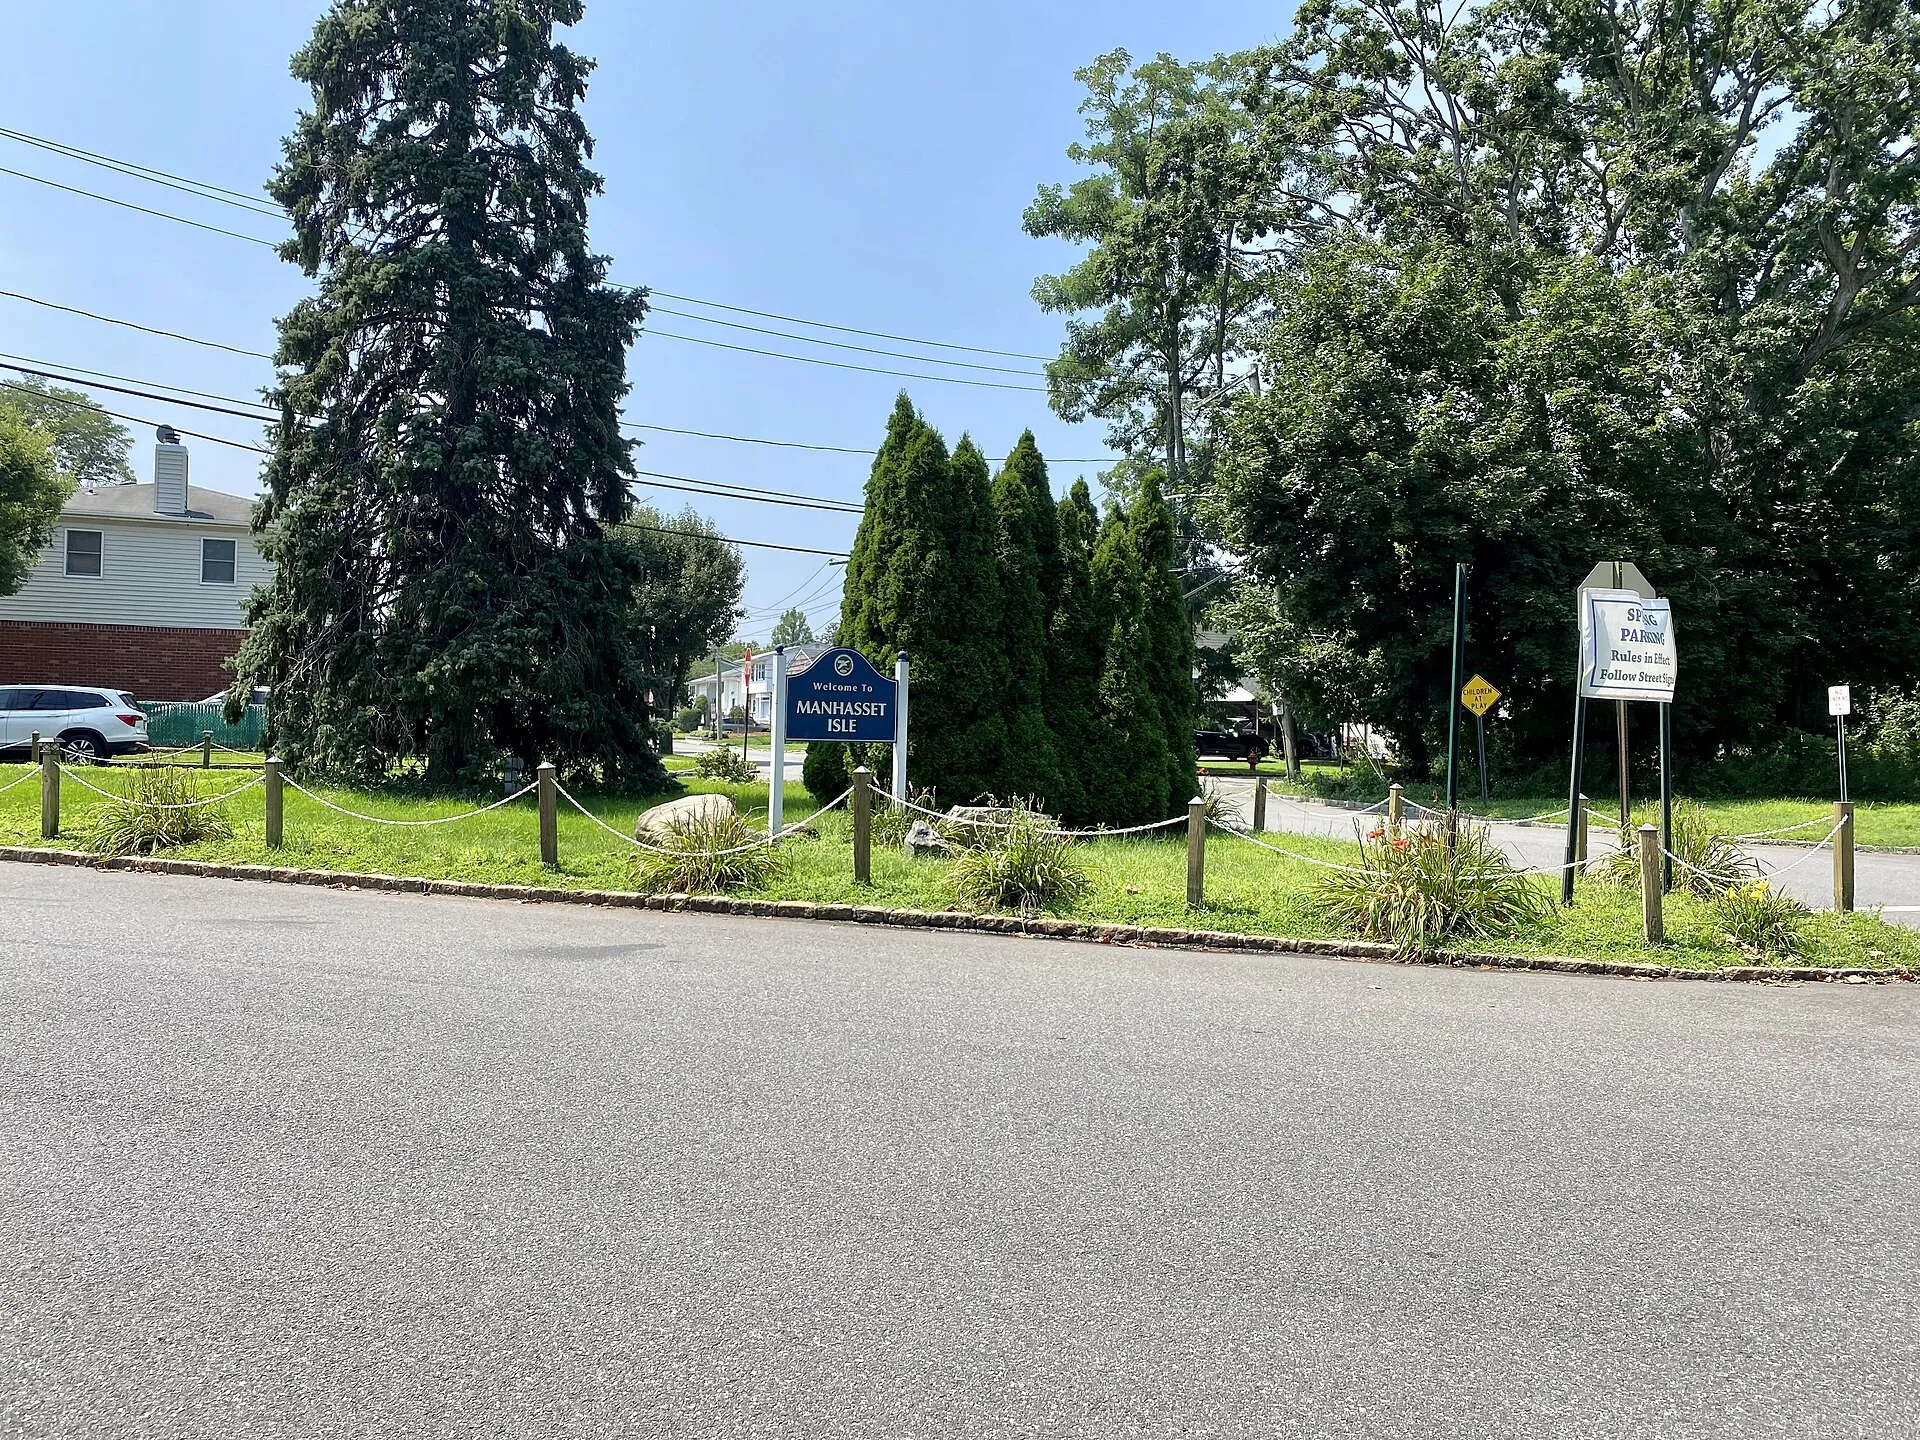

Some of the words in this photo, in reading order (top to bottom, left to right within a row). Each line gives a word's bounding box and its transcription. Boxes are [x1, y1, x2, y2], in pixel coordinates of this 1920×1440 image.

[1620, 628, 1665, 645] PARKING
[1611, 650, 1642, 663] Rules
[1644, 652, 1653, 664] in
[1654, 653, 1670, 665] Effect
[1600, 668, 1637, 681] Follow
[1638, 671, 1662, 683] Street
[813, 682, 858, 691] Welcome
[862, 684, 873, 692] To
[796, 700, 887, 716] MANHASSET
[827, 718, 857, 733] ISLE
